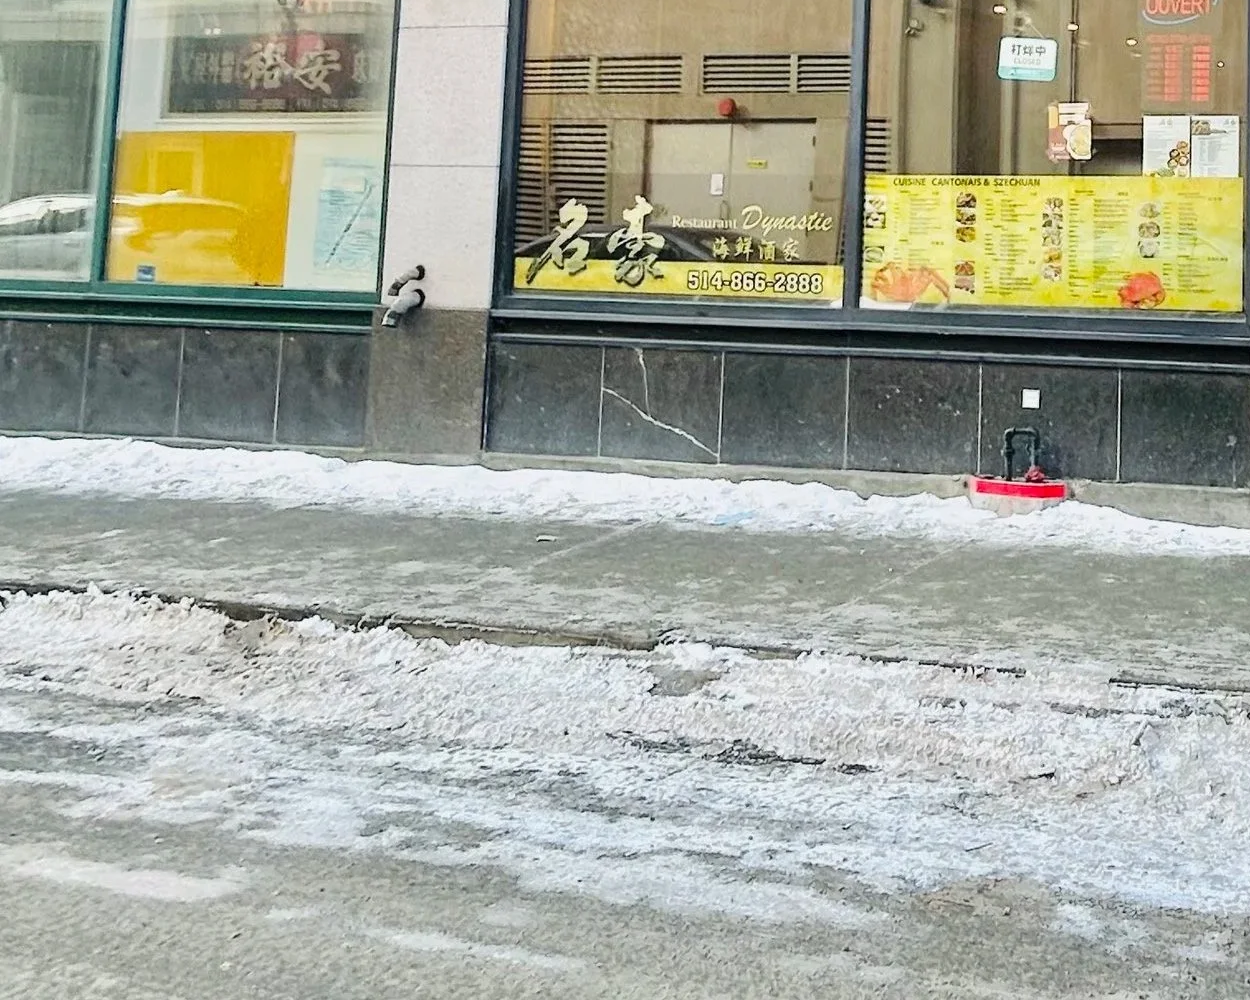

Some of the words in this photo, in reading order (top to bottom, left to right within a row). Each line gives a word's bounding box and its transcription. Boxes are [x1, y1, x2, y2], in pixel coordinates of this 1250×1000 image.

[893, 177, 926, 187] CUISINE
[931, 177, 982, 187] CANTONAIS
[993, 178, 1041, 187] SZECHUAN
[672, 215, 738, 230] Restaurant
[741, 205, 833, 236] Dynastie
[687, 269, 824, 294] 514-866-2888
